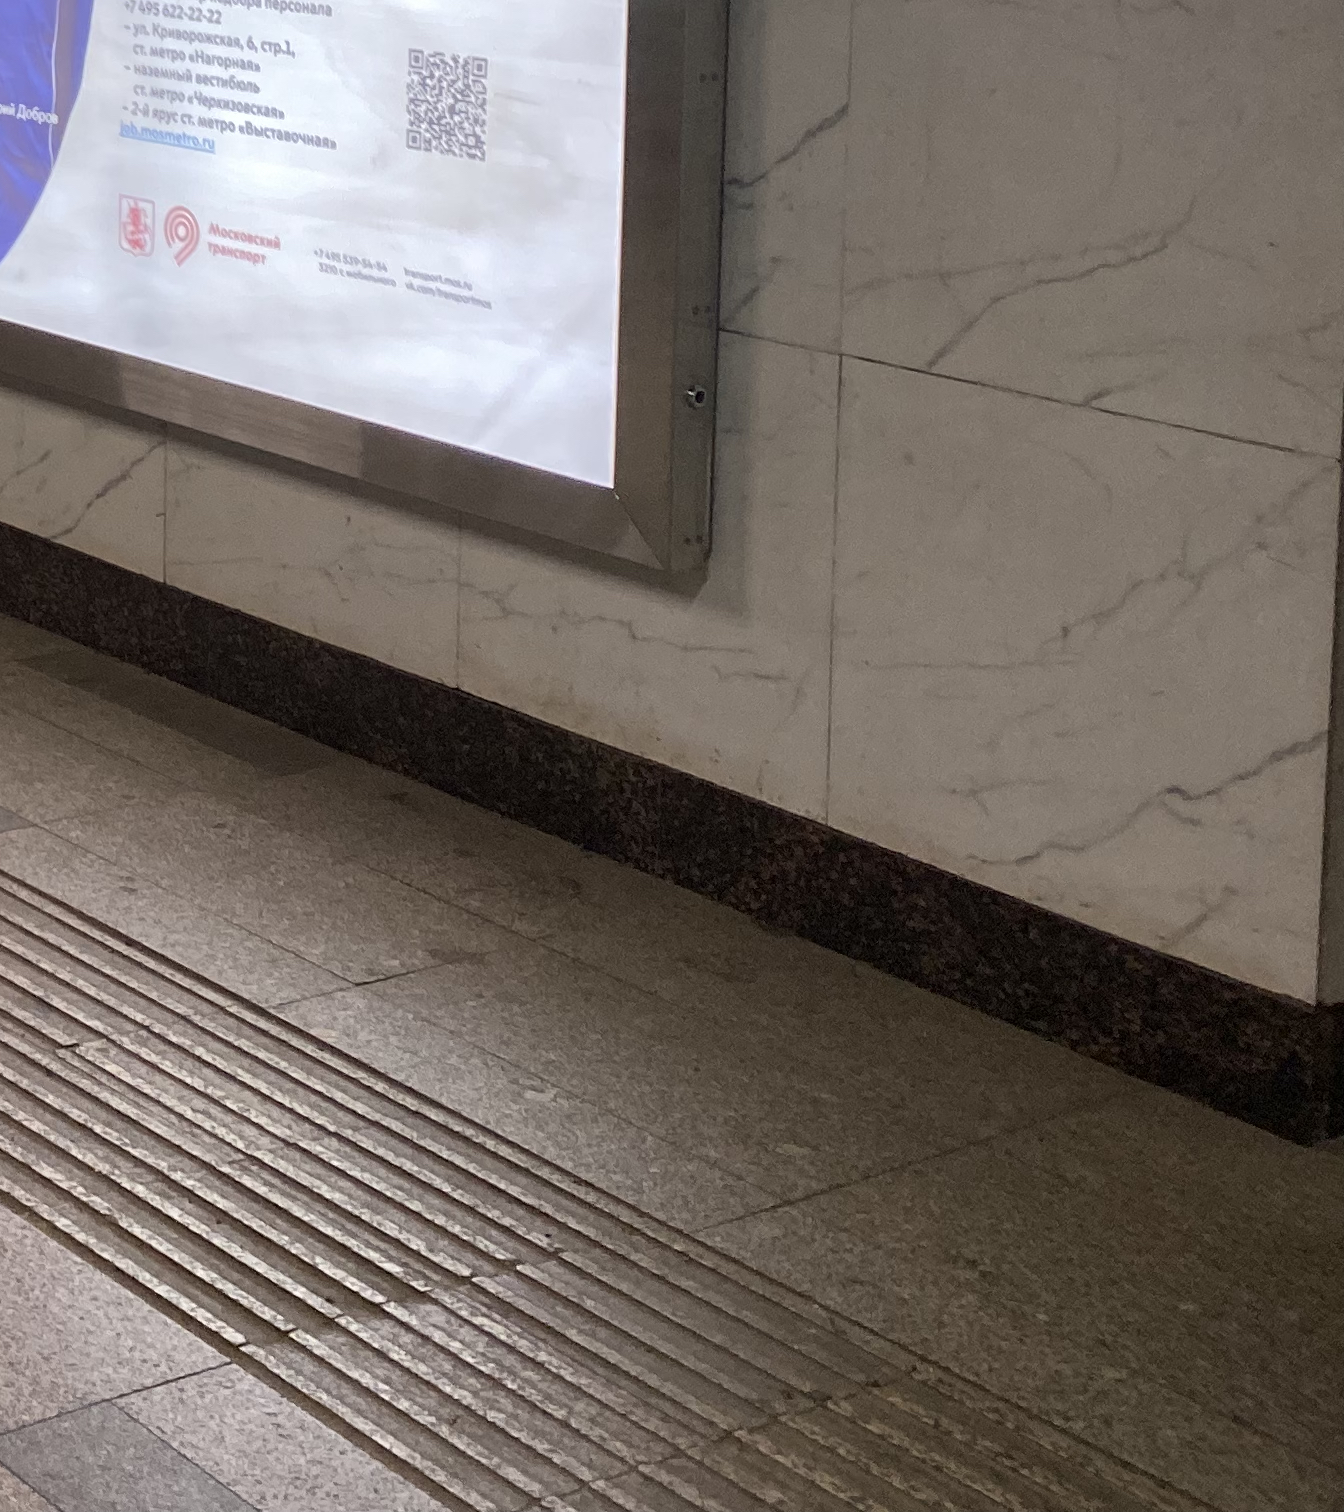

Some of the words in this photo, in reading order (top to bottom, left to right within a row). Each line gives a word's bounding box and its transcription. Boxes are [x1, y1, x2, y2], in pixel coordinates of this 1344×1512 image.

[123, 0, 137, 14] +7
[138, 0, 160, 18] 495
[161, 3, 222, 25] 622-22-22
[132, 23, 150, 38] ул.
[152, 22, 244, 53] Криворожская,
[246, 34, 258, 54] 6,
[132, 43, 148, 57] ст.
[149, 45, 187, 64] метро
[188, 49, 261, 73] «Нагорная»
[133, 64, 193, 84] наземный
[195, 73, 261, 95] вестибюль
[133, 84, 148, 98] ст.
[149, 87, 186, 105] метро
[16, 103, 59, 125] Добров
[130, 100, 150, 118] 2-й
[151, 108, 179, 125] ярус
[180, 113, 195, 127] ст.
[197, 116, 236, 135] метро
[238, 120, 337, 151] «Выставочная»
[208, 221, 281, 250] Московский
[207, 242, 267, 266] транспорт
